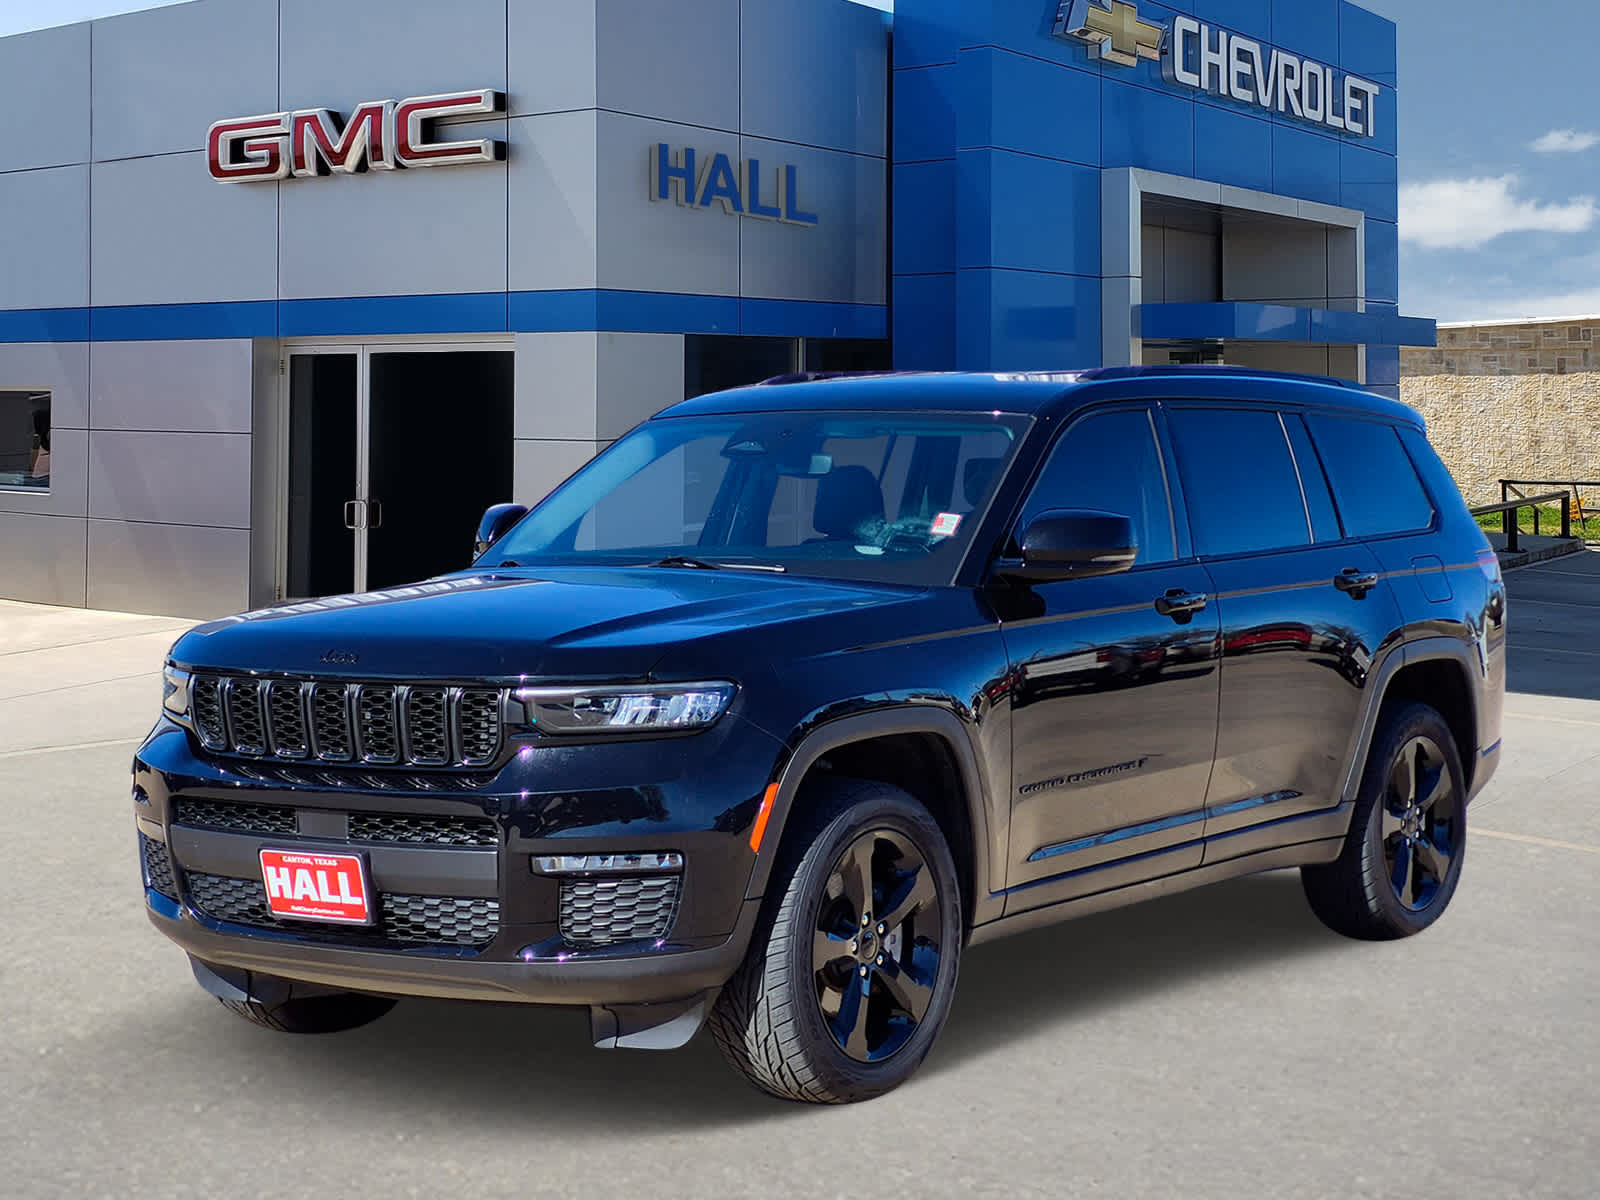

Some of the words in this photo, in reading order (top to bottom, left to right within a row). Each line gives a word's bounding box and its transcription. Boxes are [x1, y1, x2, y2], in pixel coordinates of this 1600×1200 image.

[1170, 15, 1380, 137] CHEVROLET
[205, 88, 507, 184] GMC
[650, 142, 818, 226] HALL
[265, 866, 363, 905] HALL
